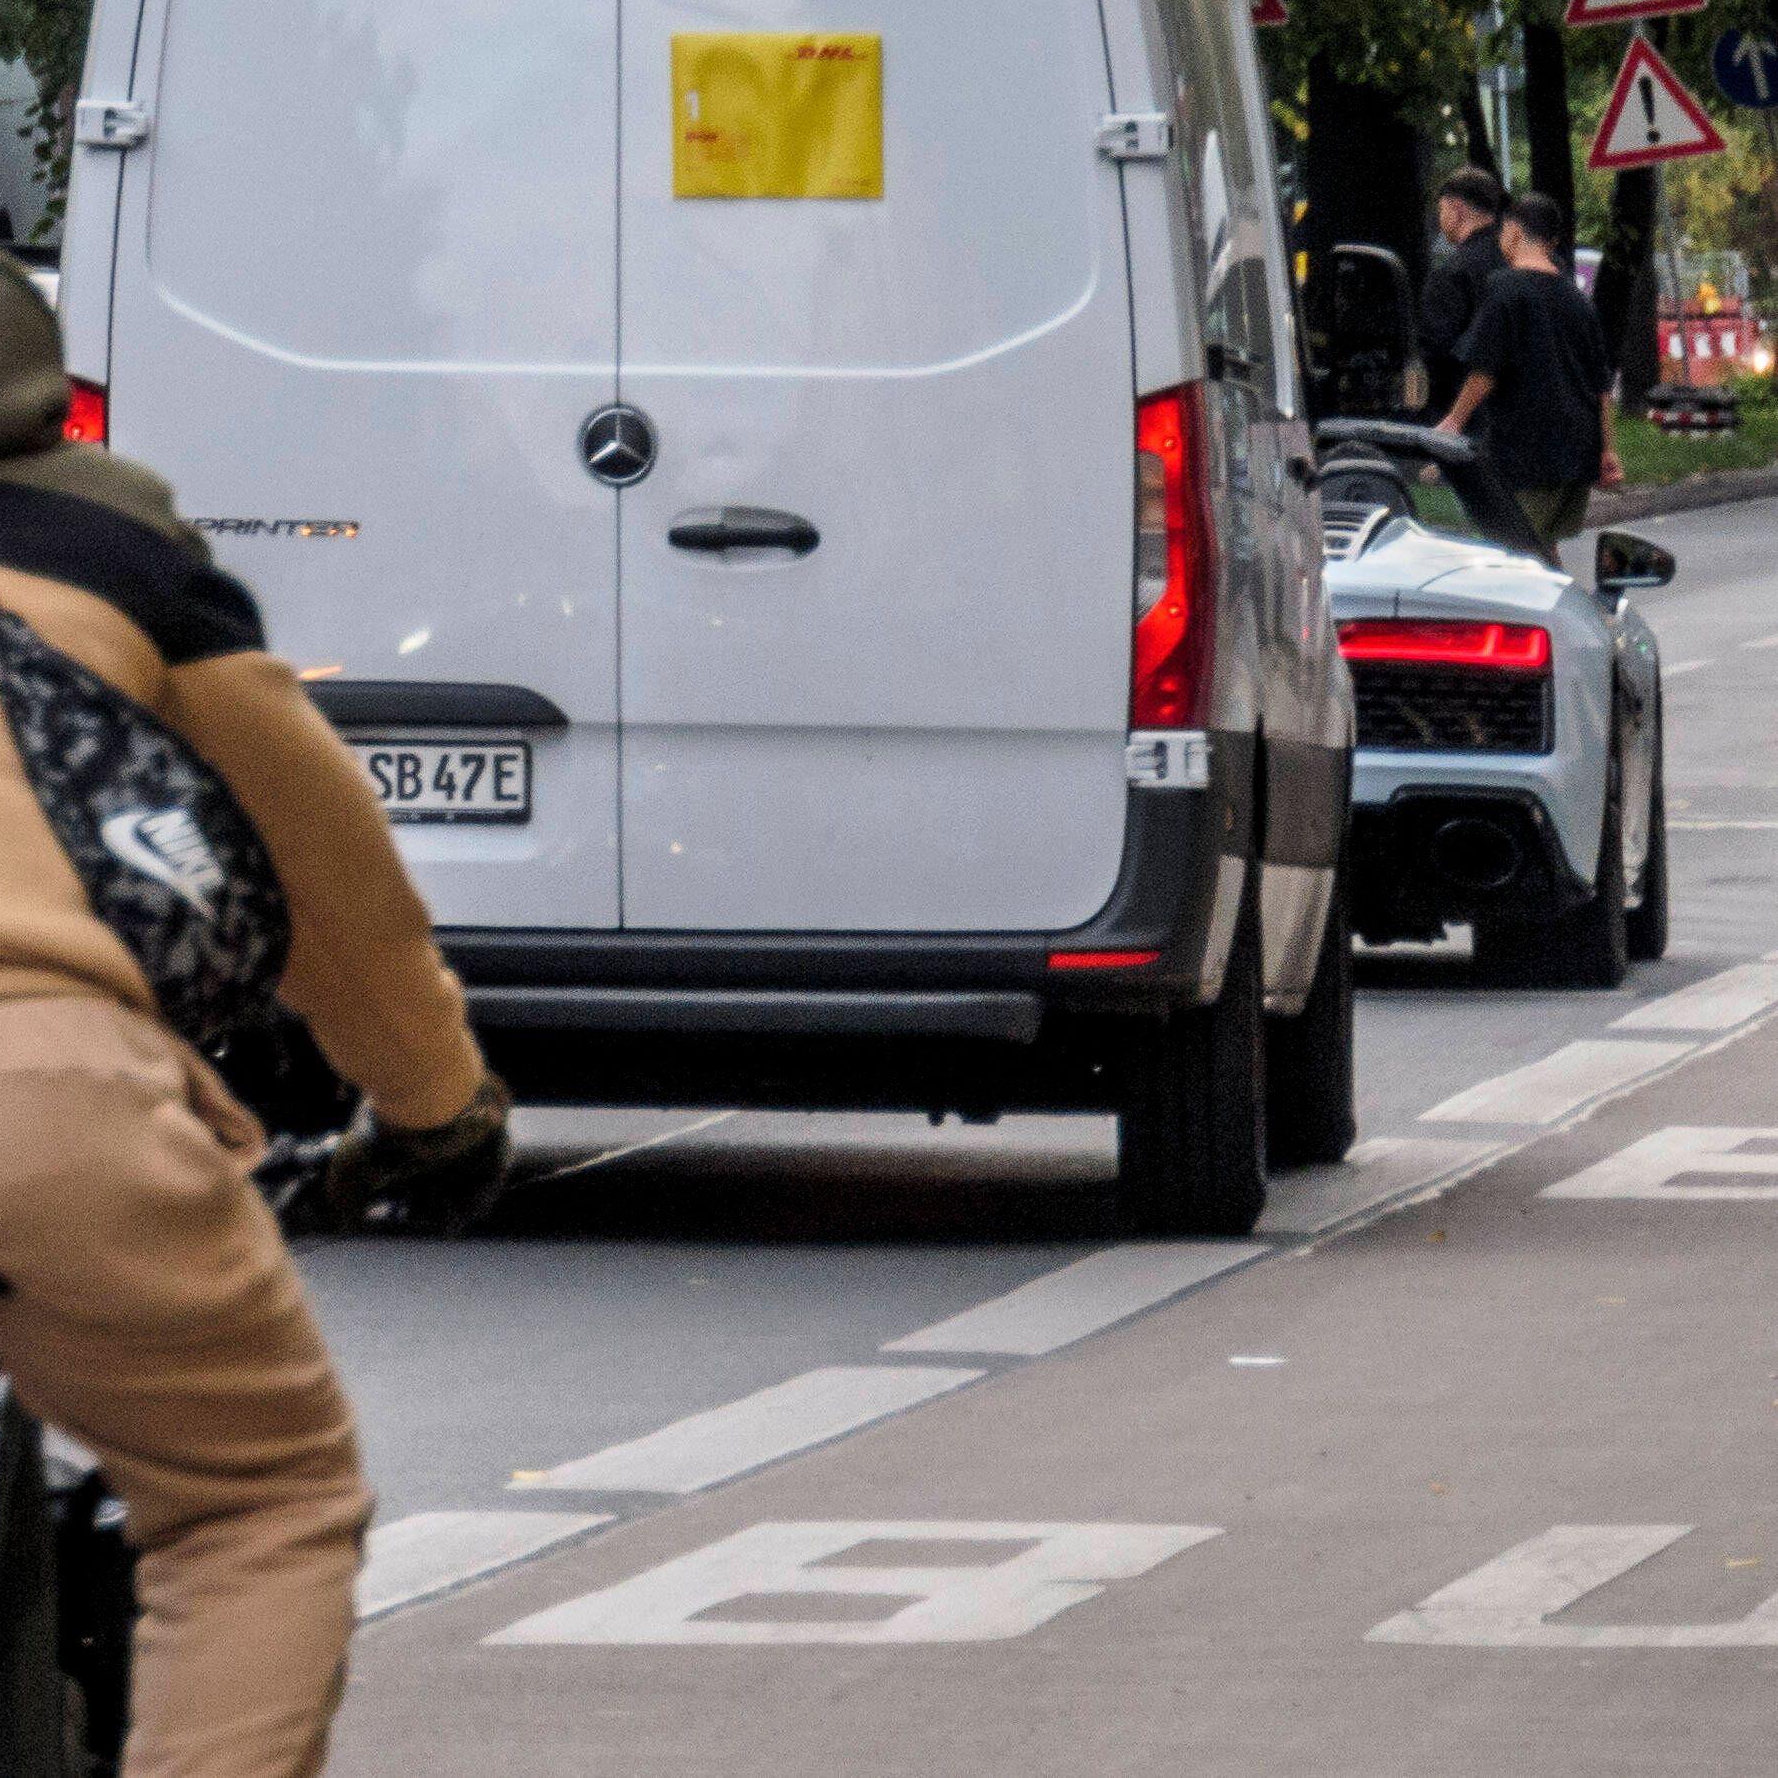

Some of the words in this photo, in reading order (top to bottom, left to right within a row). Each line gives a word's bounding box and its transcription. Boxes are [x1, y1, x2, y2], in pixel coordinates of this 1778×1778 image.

[189, 517, 360, 537] PRINTER
[369, 752, 423, 802] SB
[432, 752, 520, 802] 47E
